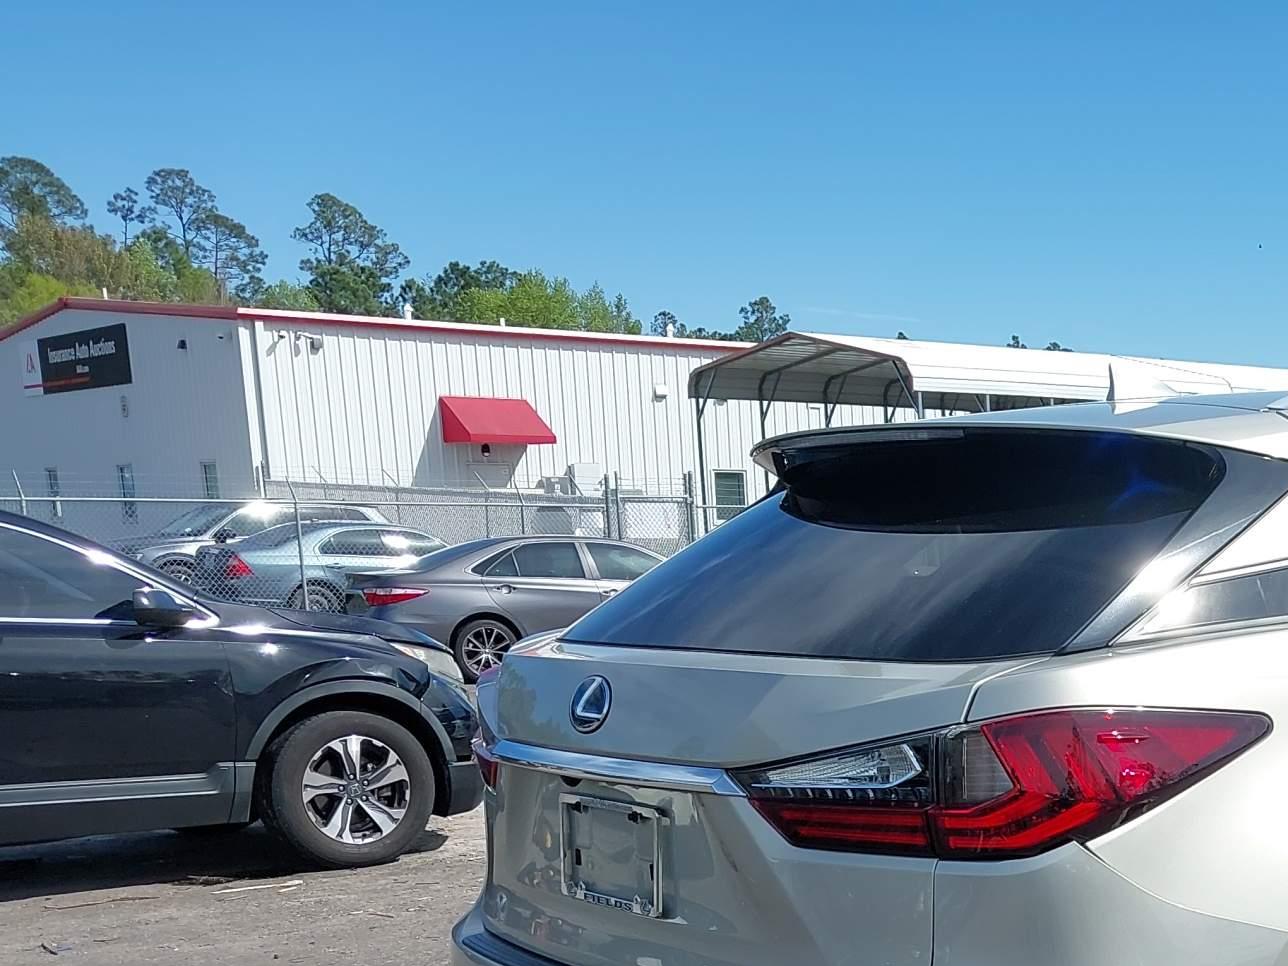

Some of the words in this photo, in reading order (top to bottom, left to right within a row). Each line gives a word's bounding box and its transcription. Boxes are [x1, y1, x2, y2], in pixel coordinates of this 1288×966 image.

[75, 341, 90, 360] Auto
[89, 337, 117, 358] Auctions
[582, 893, 633, 912] FIELDS
